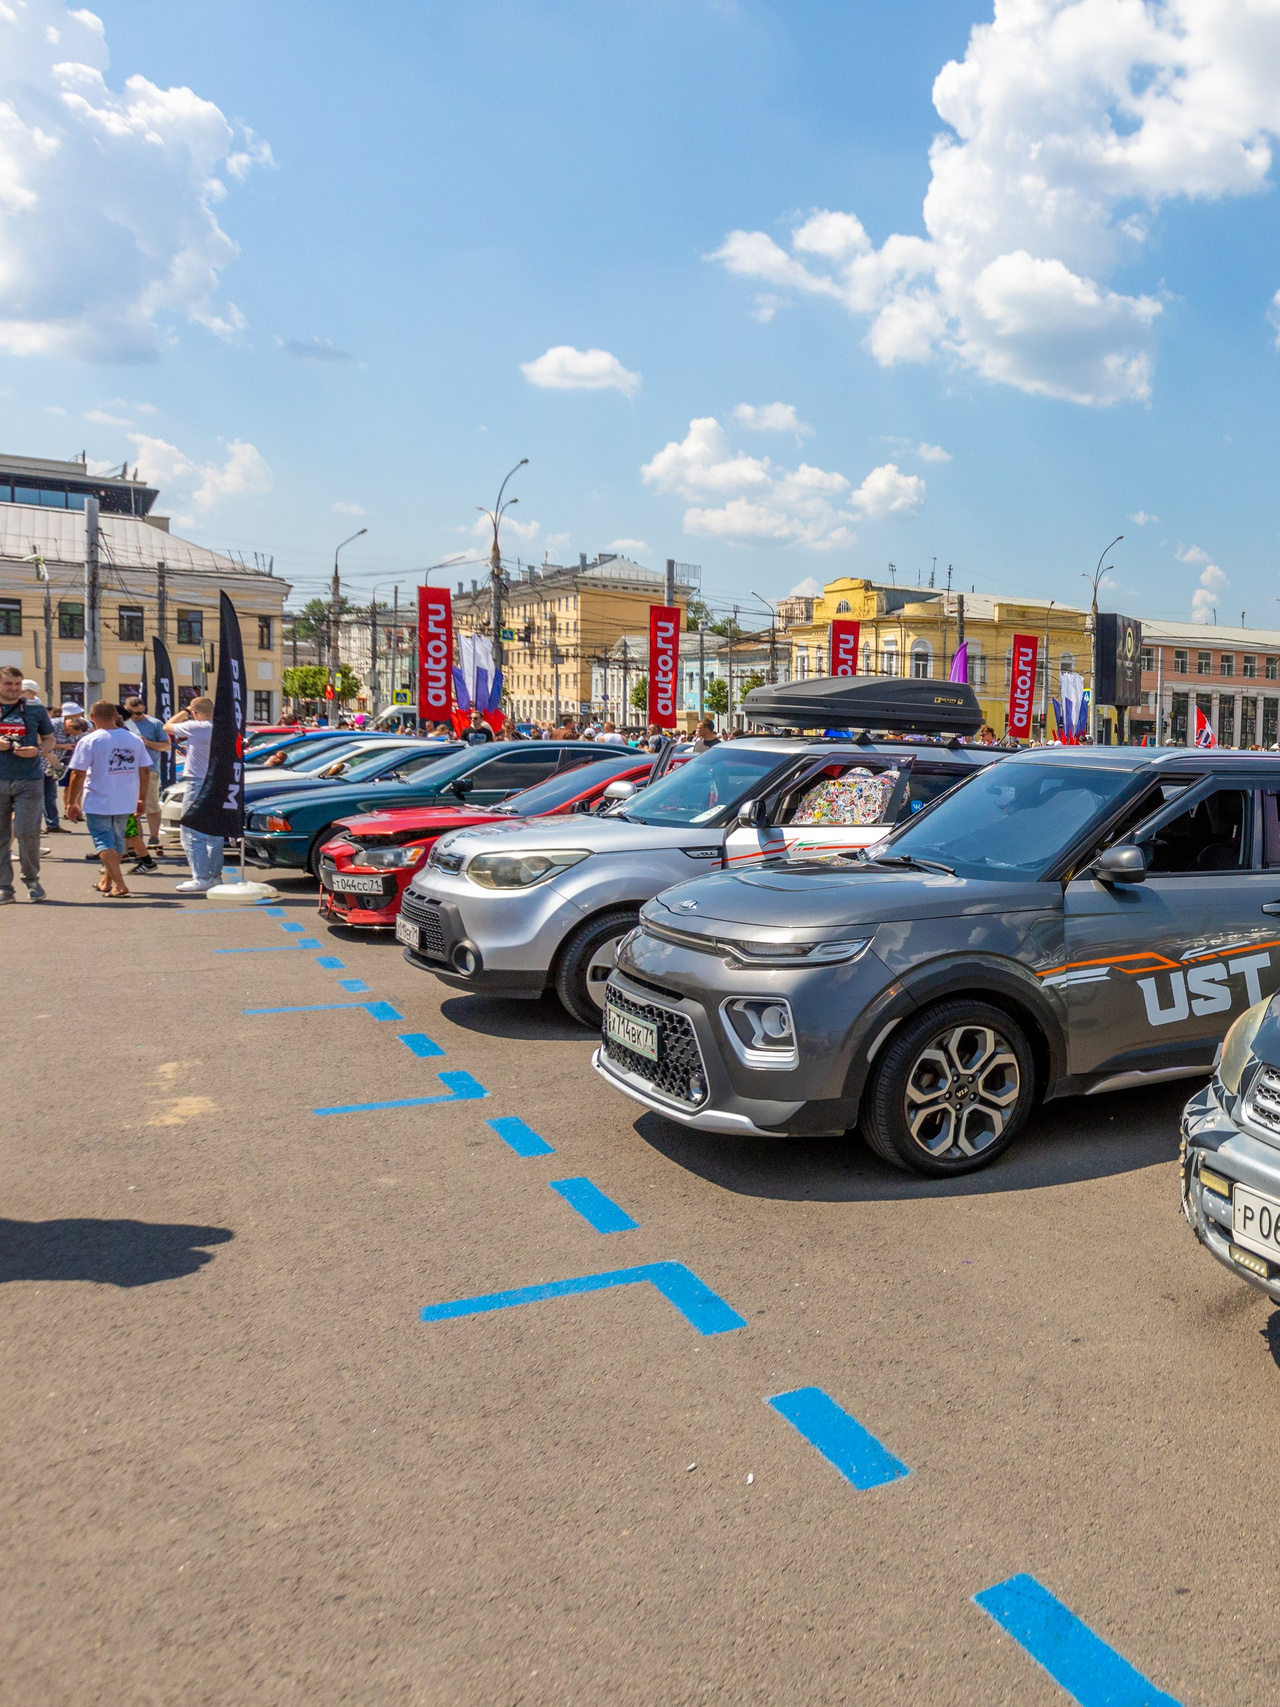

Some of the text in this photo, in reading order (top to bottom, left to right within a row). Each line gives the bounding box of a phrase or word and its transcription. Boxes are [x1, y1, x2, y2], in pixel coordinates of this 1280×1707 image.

[425, 603, 447, 707] auto.ru
[655, 621, 674, 716] auto.ru
[837, 634, 855, 676] o.ru
[1013, 647, 1033, 728] auto.ru
[1136, 952, 1271, 1026] UST
